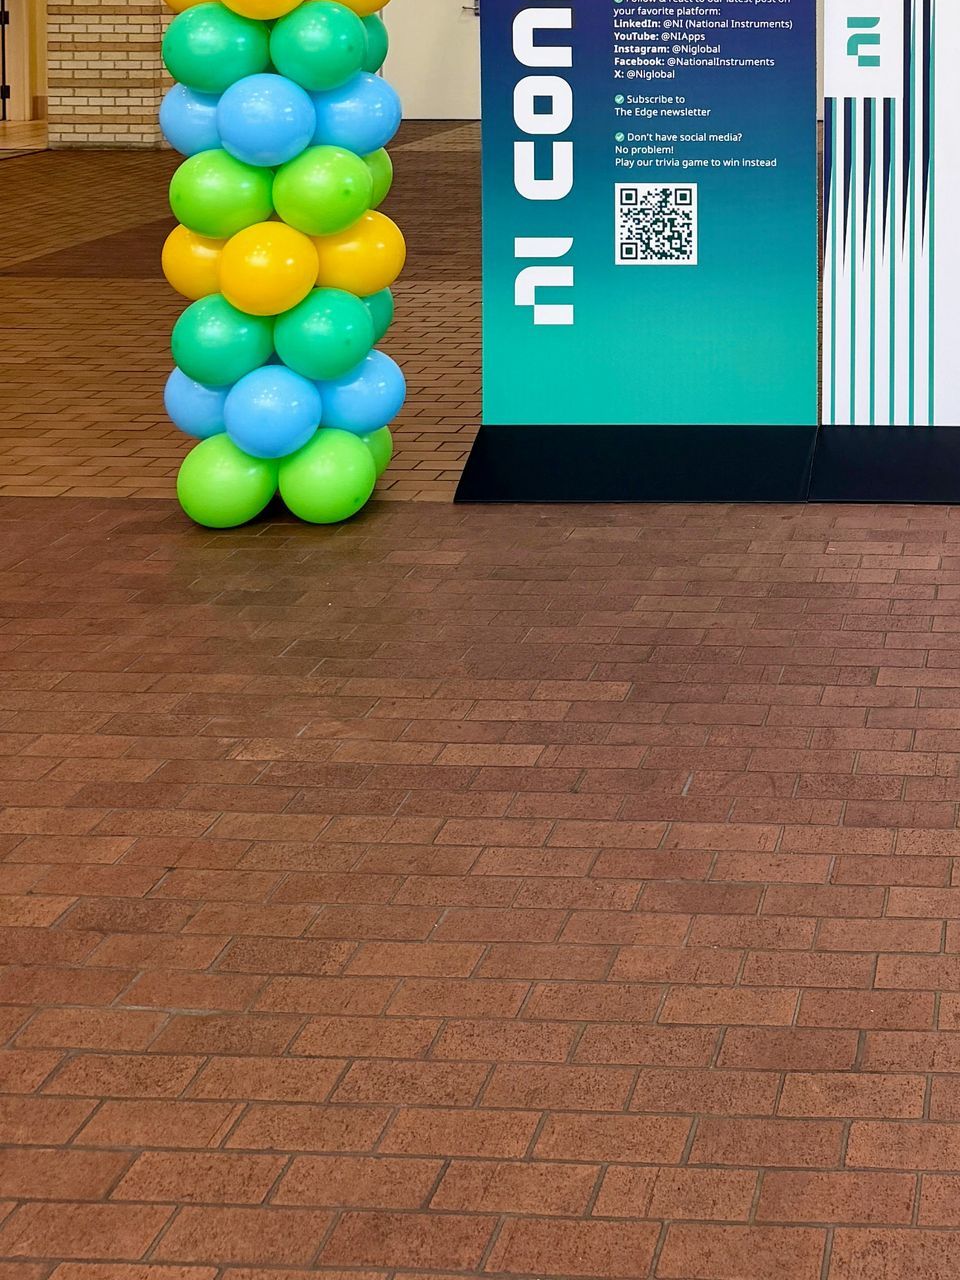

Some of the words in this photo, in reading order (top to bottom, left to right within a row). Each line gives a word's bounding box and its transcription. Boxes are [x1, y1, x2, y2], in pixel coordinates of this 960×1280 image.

[613, 8, 636, 18] your
[637, 6, 675, 16] favorite
[676, 6, 721, 18] platform:
[613, 18, 661, 28] LinkedIn:
[662, 19, 684, 29] @NI
[685, 19, 729, 30] (National
[730, 19, 793, 30] Instruments)
[613, 31, 659, 41] YouTube:
[660, 31, 706, 43] @NIApps
[613, 44, 670, 56] Instagram:
[614, 56, 665, 66] Facebook:
[666, 57, 775, 67] @NationalInstruments
[614, 69, 625, 79] X:
[626, 94, 674, 104] Subscribe
[675, 95, 686, 104] to
[614, 107, 633, 117] The
[634, 107, 659, 119] Edge
[660, 107, 712, 117] newsletter
[627, 132, 653, 142] Don't
[655, 132, 678, 142] have
[679, 132, 707, 142] social
[708, 132, 743, 142] media?
[615, 145, 629, 154] No
[631, 145, 674, 156] problem!
[615, 157, 635, 169] Play
[636, 159, 654, 167] our
[655, 157, 680, 167] trivia
[681, 159, 709, 169] game
[710, 158, 721, 167] to
[722, 158, 740, 167] win
[742, 158, 777, 167] instead
